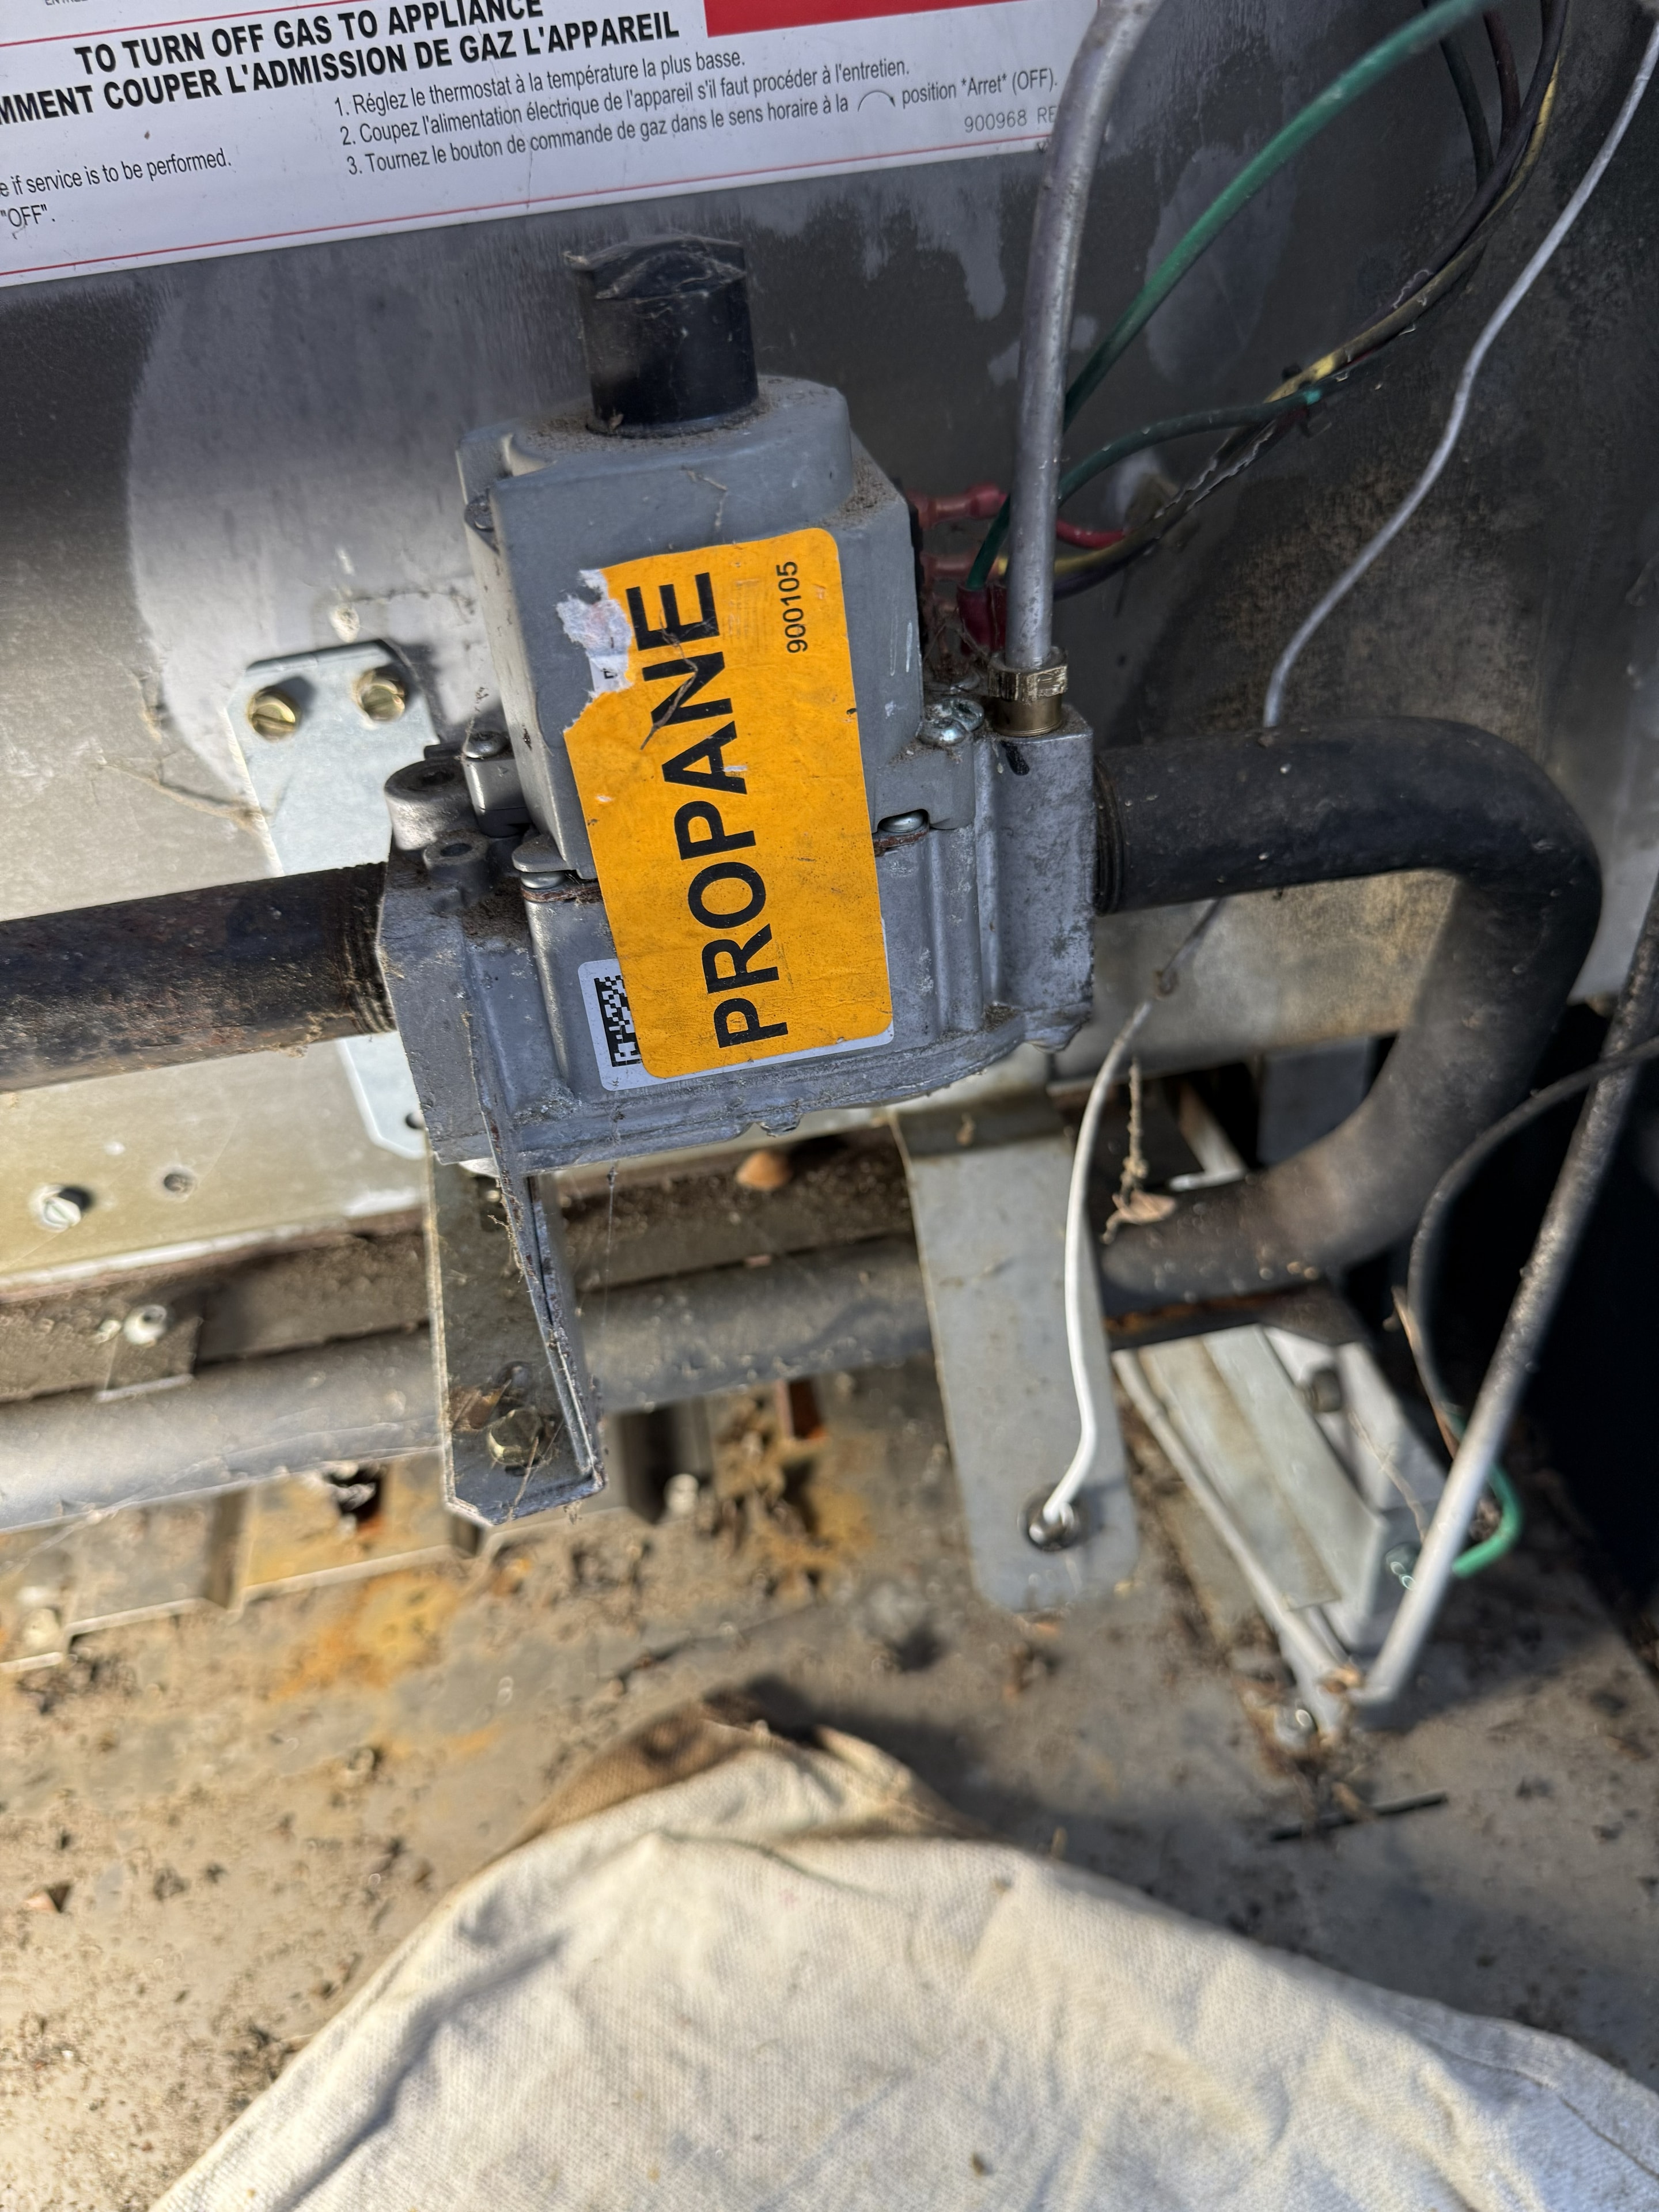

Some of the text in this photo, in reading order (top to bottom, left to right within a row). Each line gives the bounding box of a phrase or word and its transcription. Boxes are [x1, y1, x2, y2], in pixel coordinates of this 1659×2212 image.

[74, 0, 544, 74] TO TURN OFF GAS TO APPLIANCE
[104, 69, 223, 109] COUPER
[226, 44, 408, 93] L'ADMISSION
[414, 39, 453, 69] DE
[460, 31, 517, 63] GAZ
[523, 11, 680, 56] L'APPAREIL
[335, 51, 745, 116] 1. Réglez le thermostat à la température la plus basse.
[340, 58, 910, 145] 2. Coupez l'alimentation électrique de l'appareil s'il faut procéder à l'entretien.
[347, 156, 363, 175] 3.
[365, 149, 430, 172] Tournez
[432, 145, 447, 164] le
[450, 139, 503, 161] bouton
[507, 134, 526, 154] de
[530, 123, 613, 151] commande
[617, 120, 636, 140] de
[640, 119, 668, 142] gaz
[671, 113, 707, 133] dans
[711, 109, 724, 128] le
[728, 108, 763, 126] sens
[767, 98, 818, 121] horaire
[823, 96, 831, 114] à
[835, 93, 849, 112] la
[902, 81, 956, 109] position
[1012, 68, 1058, 96] (OFF).
[964, 109, 1027, 133] 900968
[10, 173, 24, 196] if
[26, 171, 82, 193] service
[84, 166, 100, 185] is
[103, 165, 119, 183] to
[121, 161, 143, 180] be
[146, 147, 232, 181] performed.
[775, 561, 808, 654] 900105
[626, 571, 789, 1050] PROPANE
